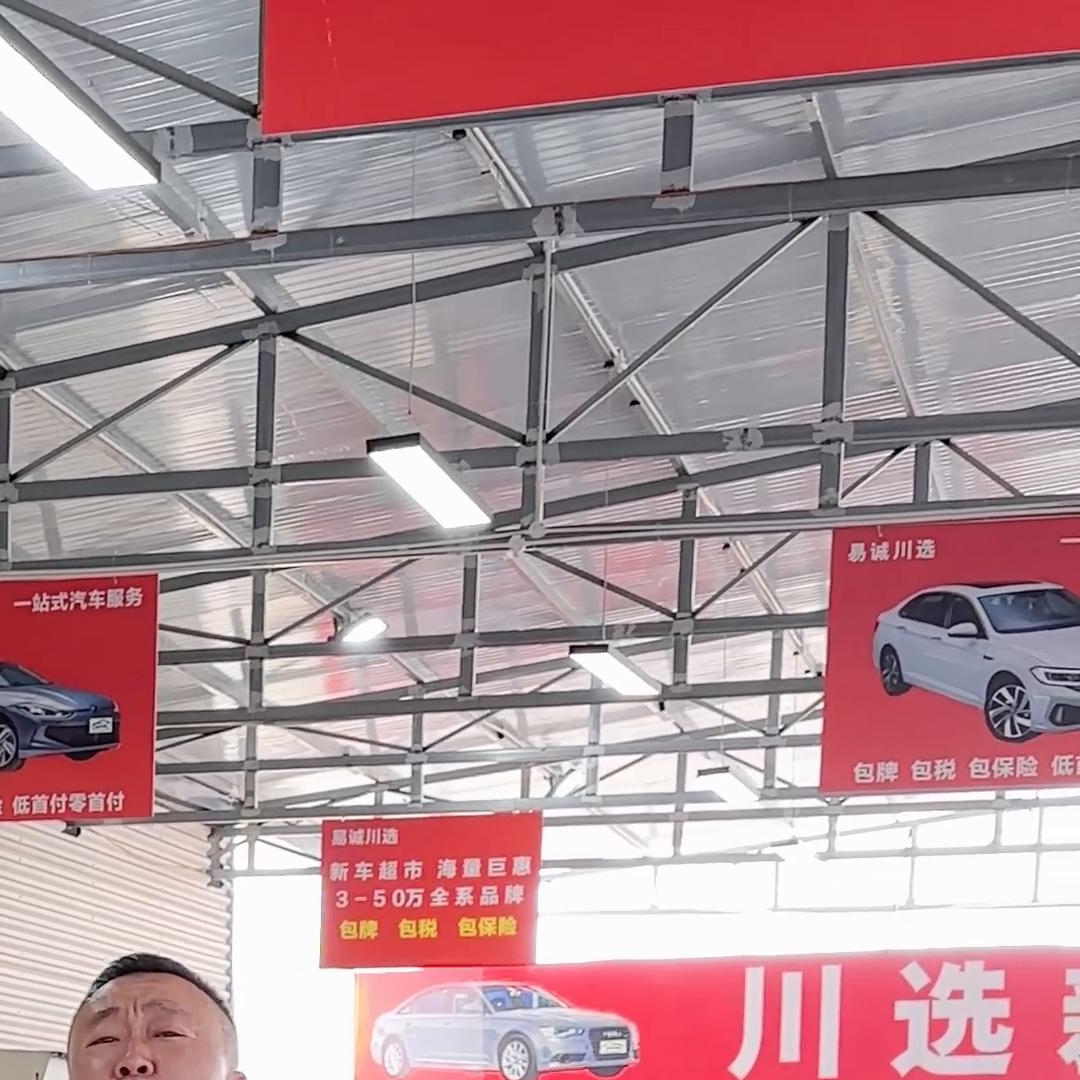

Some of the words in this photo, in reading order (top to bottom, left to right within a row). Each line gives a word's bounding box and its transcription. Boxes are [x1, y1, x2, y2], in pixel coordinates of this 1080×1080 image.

[848, 539, 936, 562] 易诚川选
[13, 586, 144, 614] 一站式汽车服务
[853, 760, 899, 784] 包牌
[911, 757, 956, 782] 包税
[968, 755, 1038, 779] 包保险
[1051, 754, 1080, 777] 低
[11, 791, 125, 815] 低首付零首付
[331, 828, 399, 846] 易诚川选
[329, 860, 425, 882] 新车超市
[436, 855, 533, 880] 海量巨惠
[339, 919, 380, 940] 包牌
[398, 917, 438, 939] 包税
[458, 915, 519, 938] 包保险
